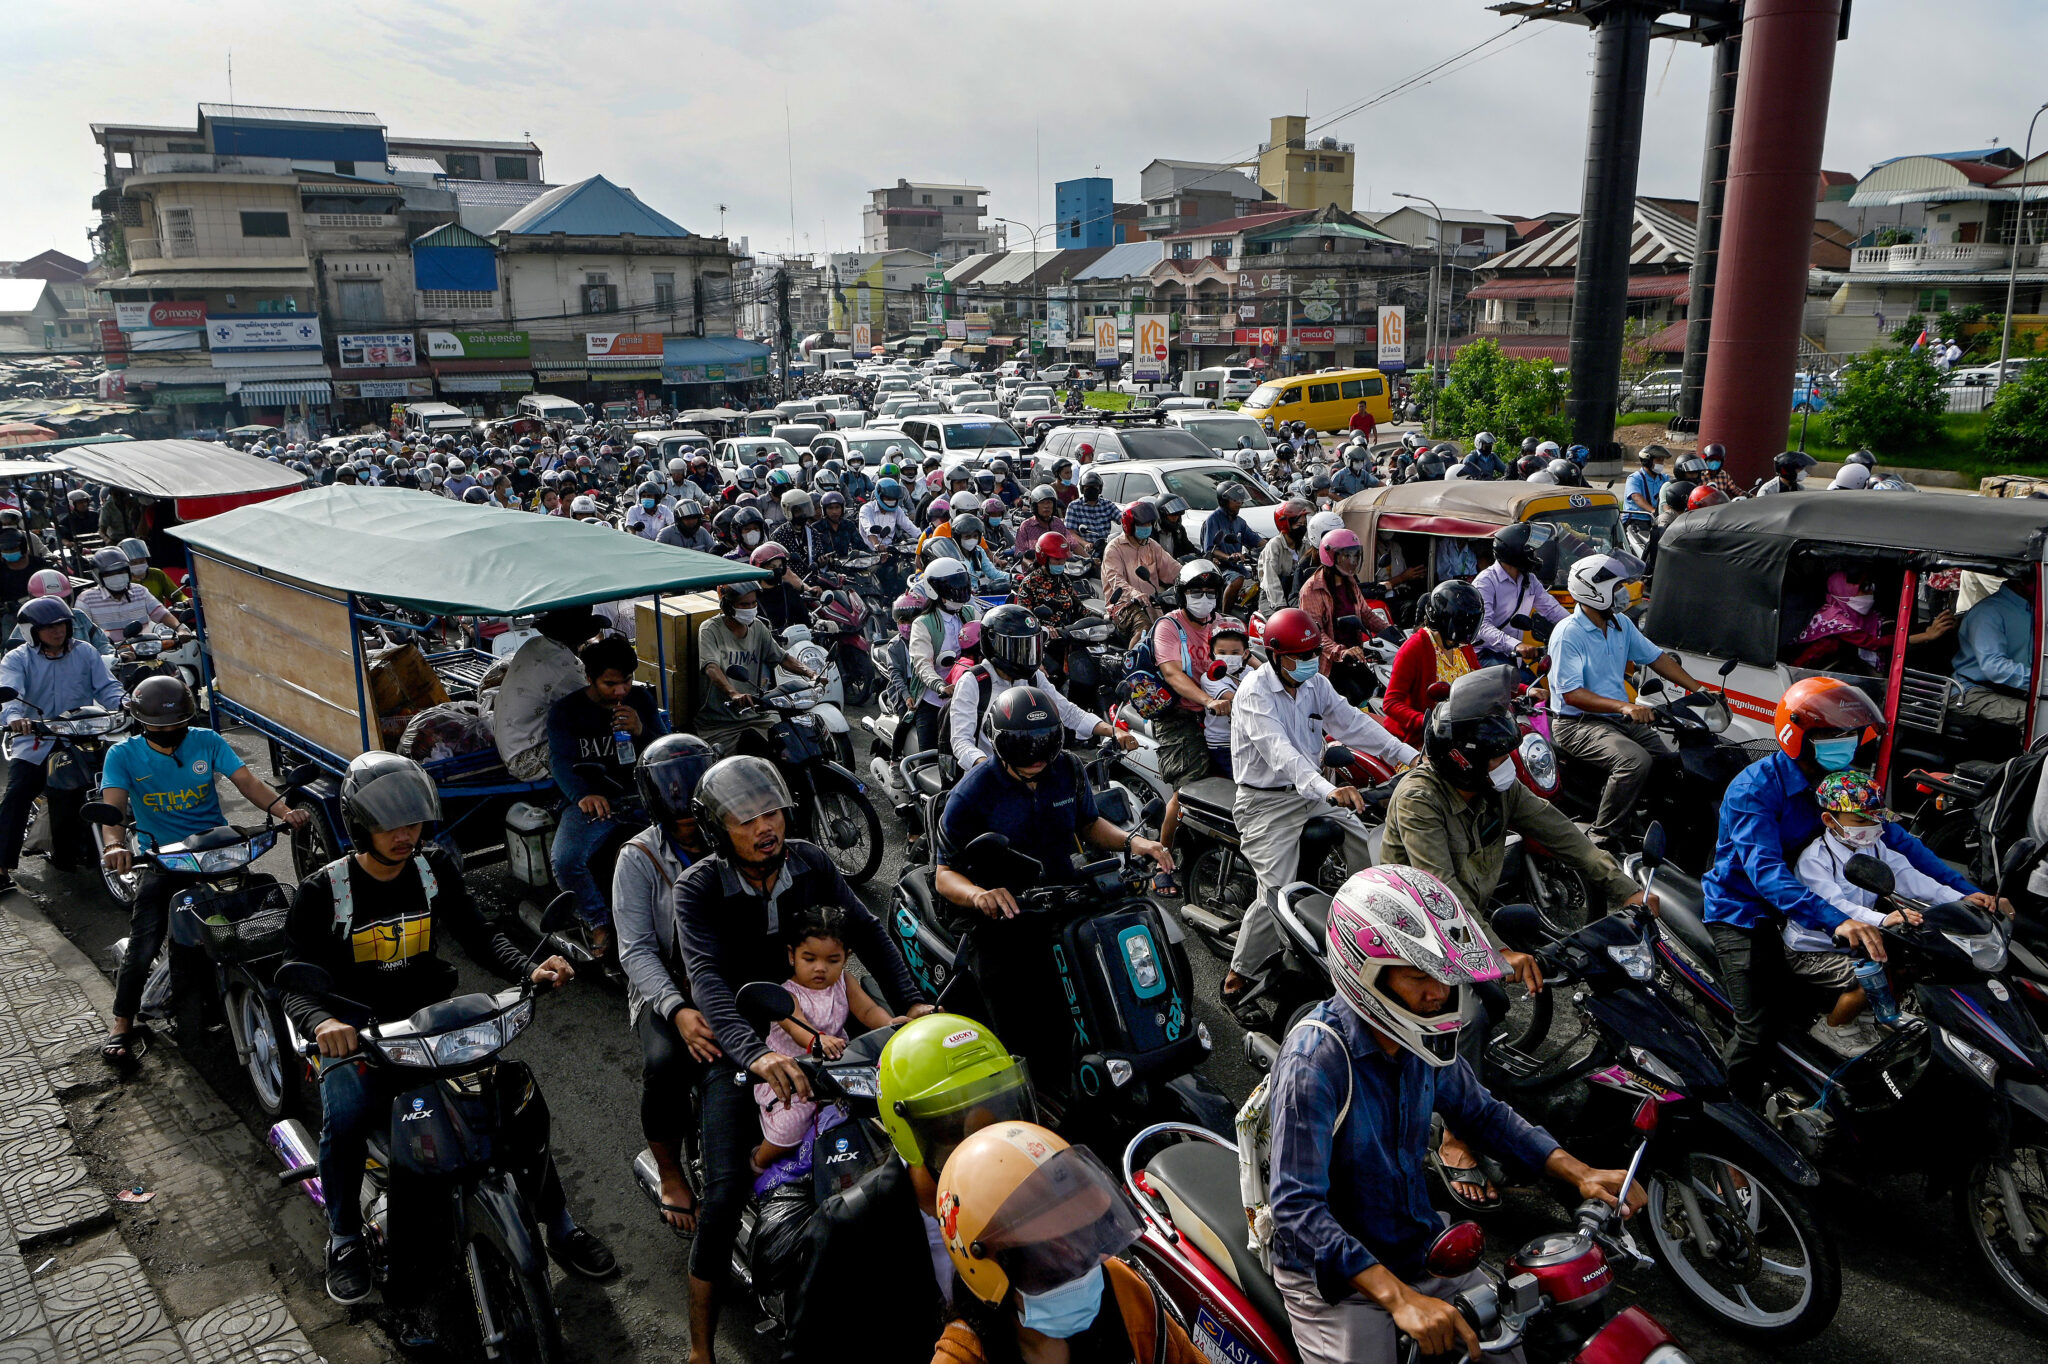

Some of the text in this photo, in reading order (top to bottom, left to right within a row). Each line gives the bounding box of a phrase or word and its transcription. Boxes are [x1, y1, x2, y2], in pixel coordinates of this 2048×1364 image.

[169, 310, 201, 319] money
[1098, 322, 1115, 347] KS
[1141, 320, 1165, 354] KS
[1383, 311, 1402, 344] KS
[434, 342, 457, 351] Wing
[721, 650, 758, 665] PUMA
[579, 736, 614, 758] BAZ
[143, 784, 208, 806] ETIHAD
[949, 1031, 973, 1043] LUCKY
[1626, 1071, 1668, 1095] SUZUKI
[401, 1110, 434, 1122] NCX
[826, 1151, 859, 1164] NCX
[1582, 1264, 1608, 1283] HONDA
[1197, 1328, 1236, 1364] INSUR
[1225, 1341, 1259, 1364] ASI
